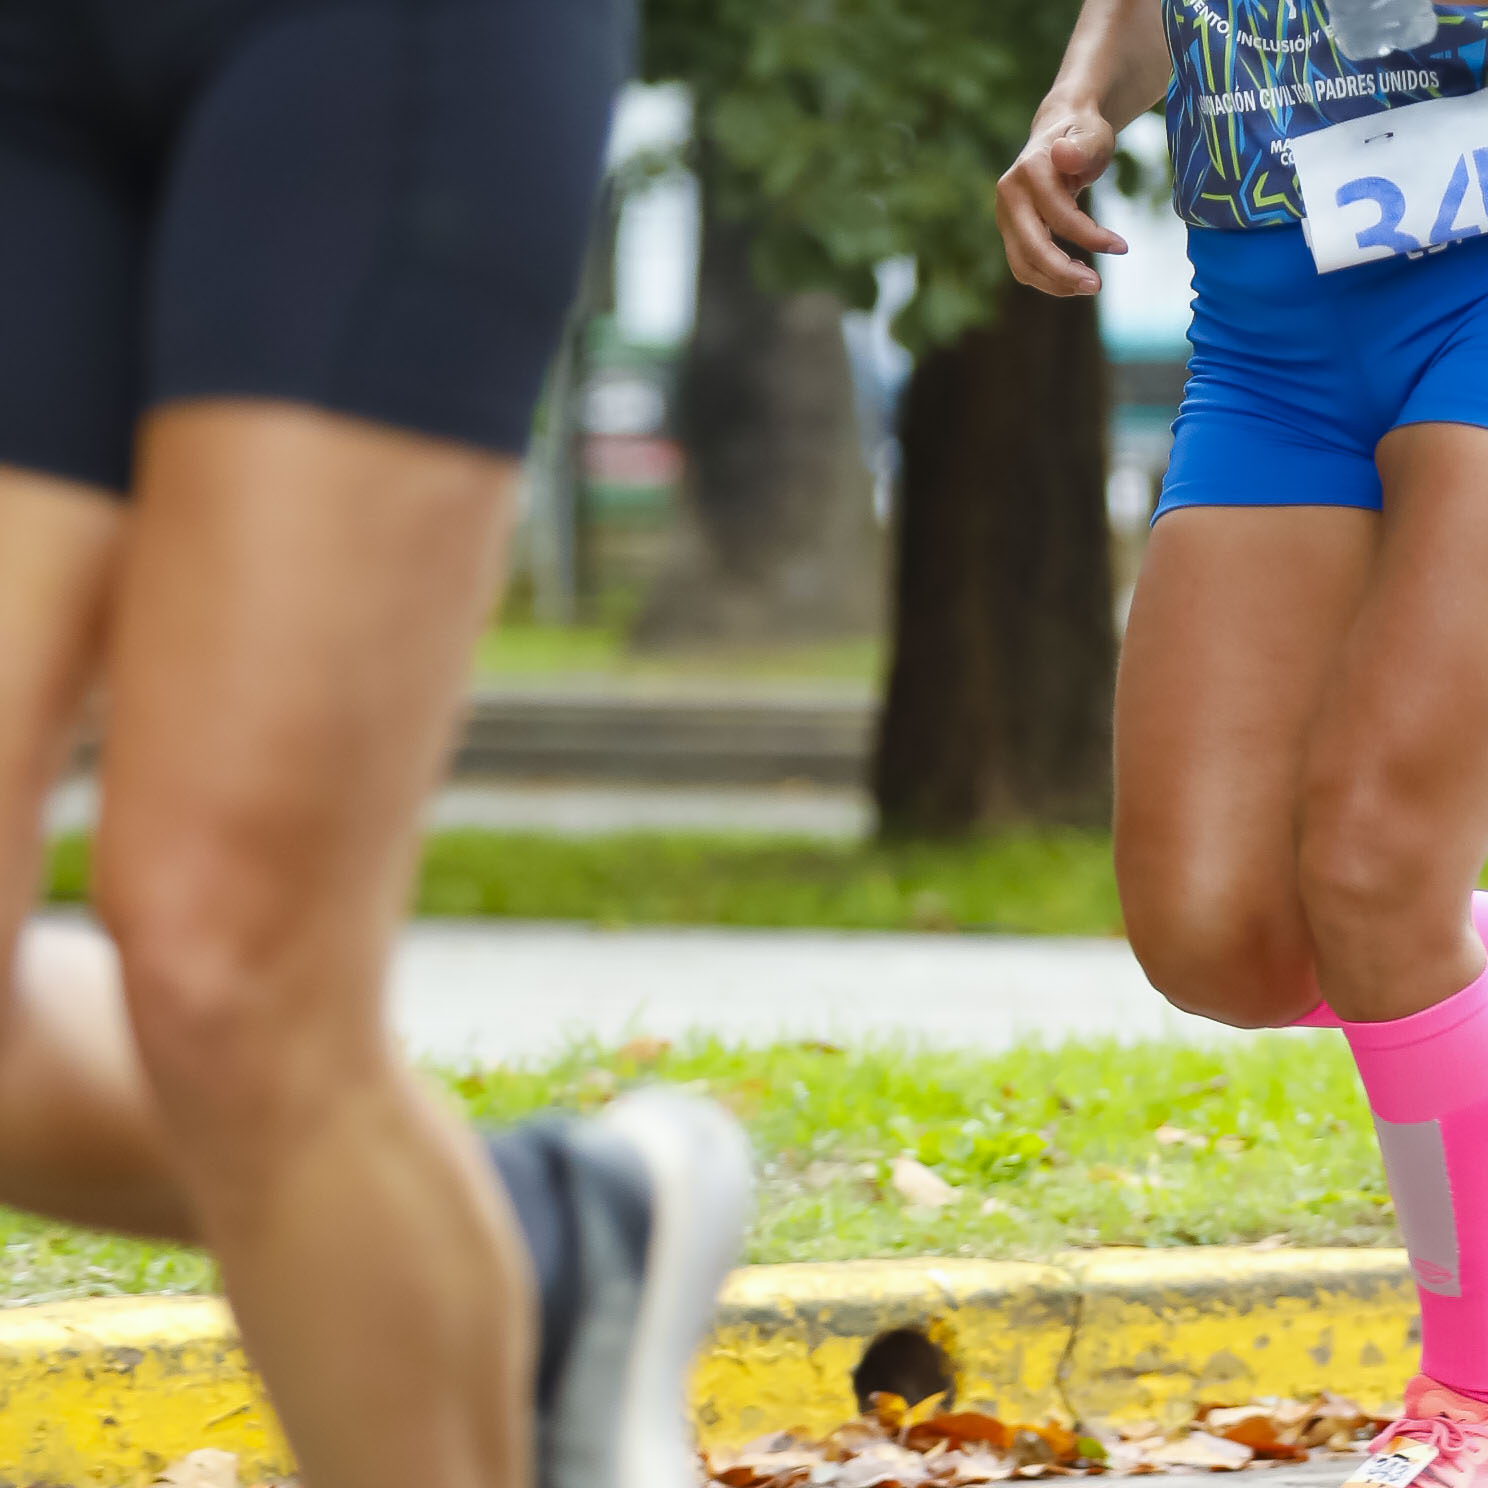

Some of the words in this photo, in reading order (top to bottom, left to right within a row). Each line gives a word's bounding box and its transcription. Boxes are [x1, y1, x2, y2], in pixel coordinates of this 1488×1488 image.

[1311, 28, 1321, 45] Y
[1259, 84, 1296, 110] CIVIL
[1315, 73, 1376, 102] PADRES
[1378, 69, 1441, 94] UNIDOS
